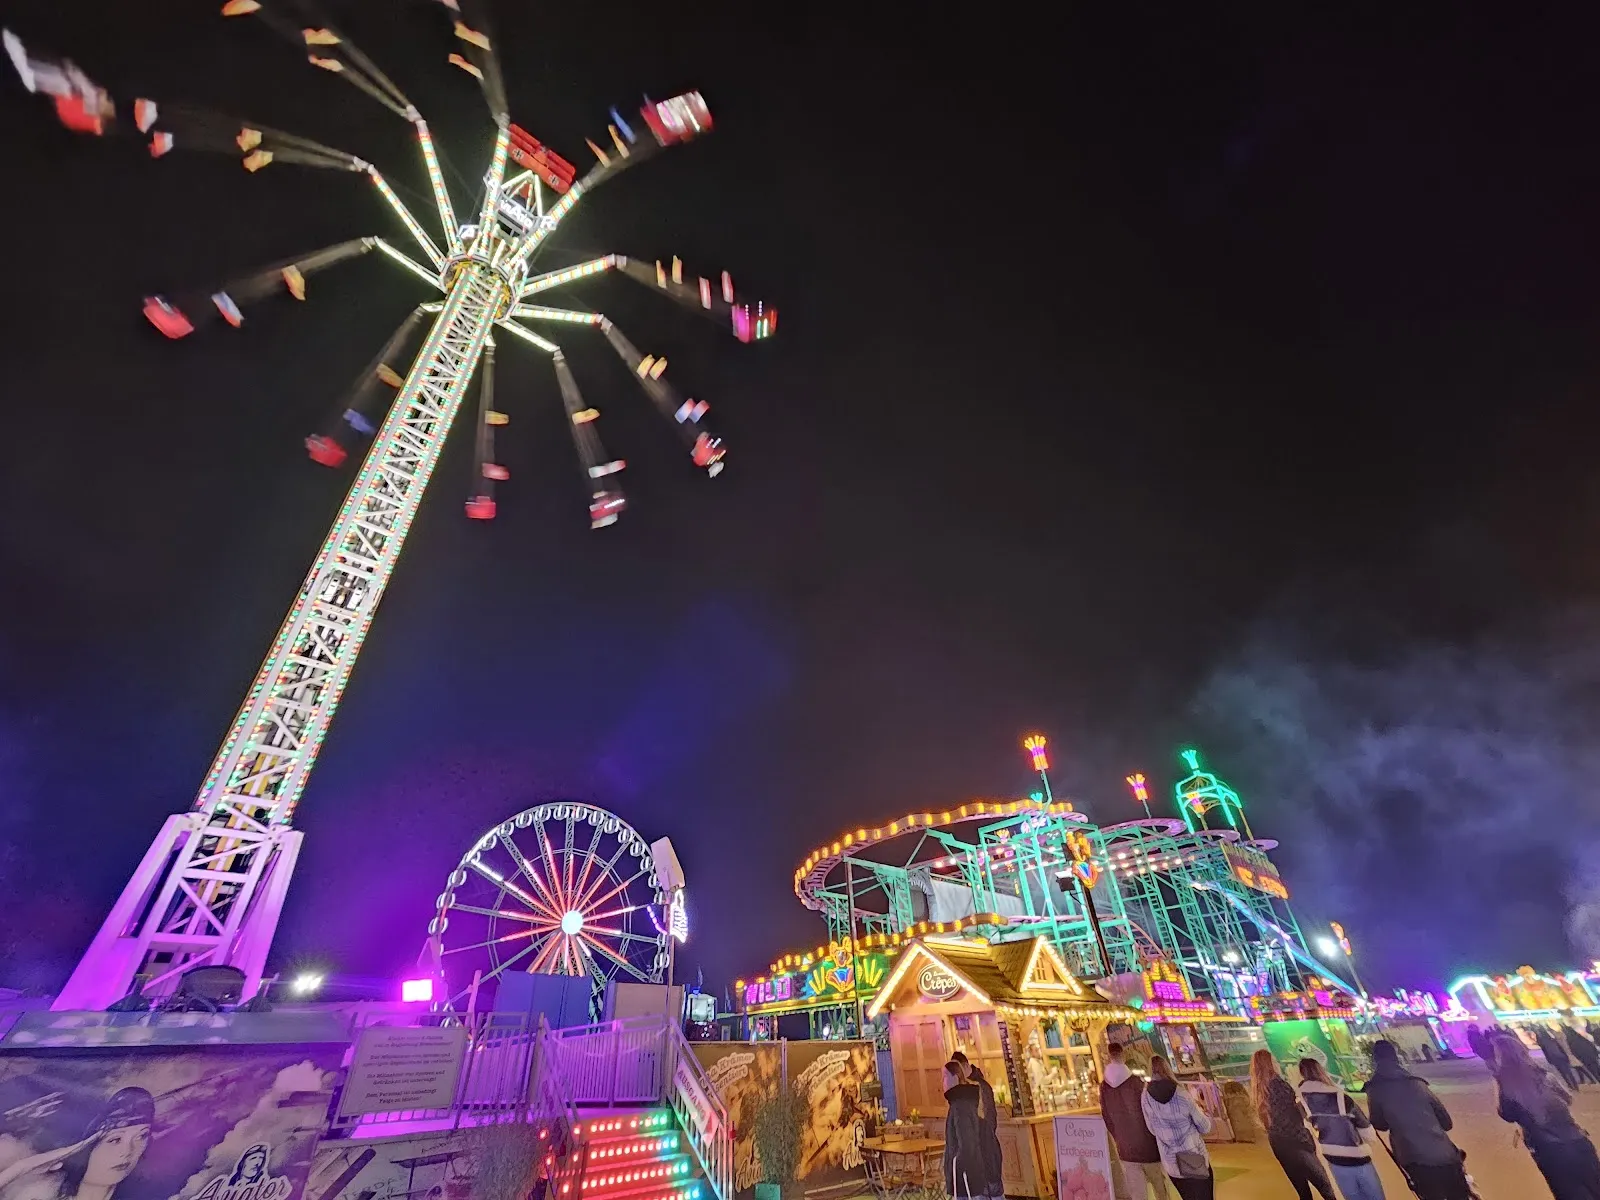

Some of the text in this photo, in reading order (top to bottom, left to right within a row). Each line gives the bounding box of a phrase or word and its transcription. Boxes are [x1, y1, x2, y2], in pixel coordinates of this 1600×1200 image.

[920, 971, 957, 994] Crêpes
[1060, 1145, 1104, 1159] Erdbeeren
[195, 1177, 287, 1200] Aviator
